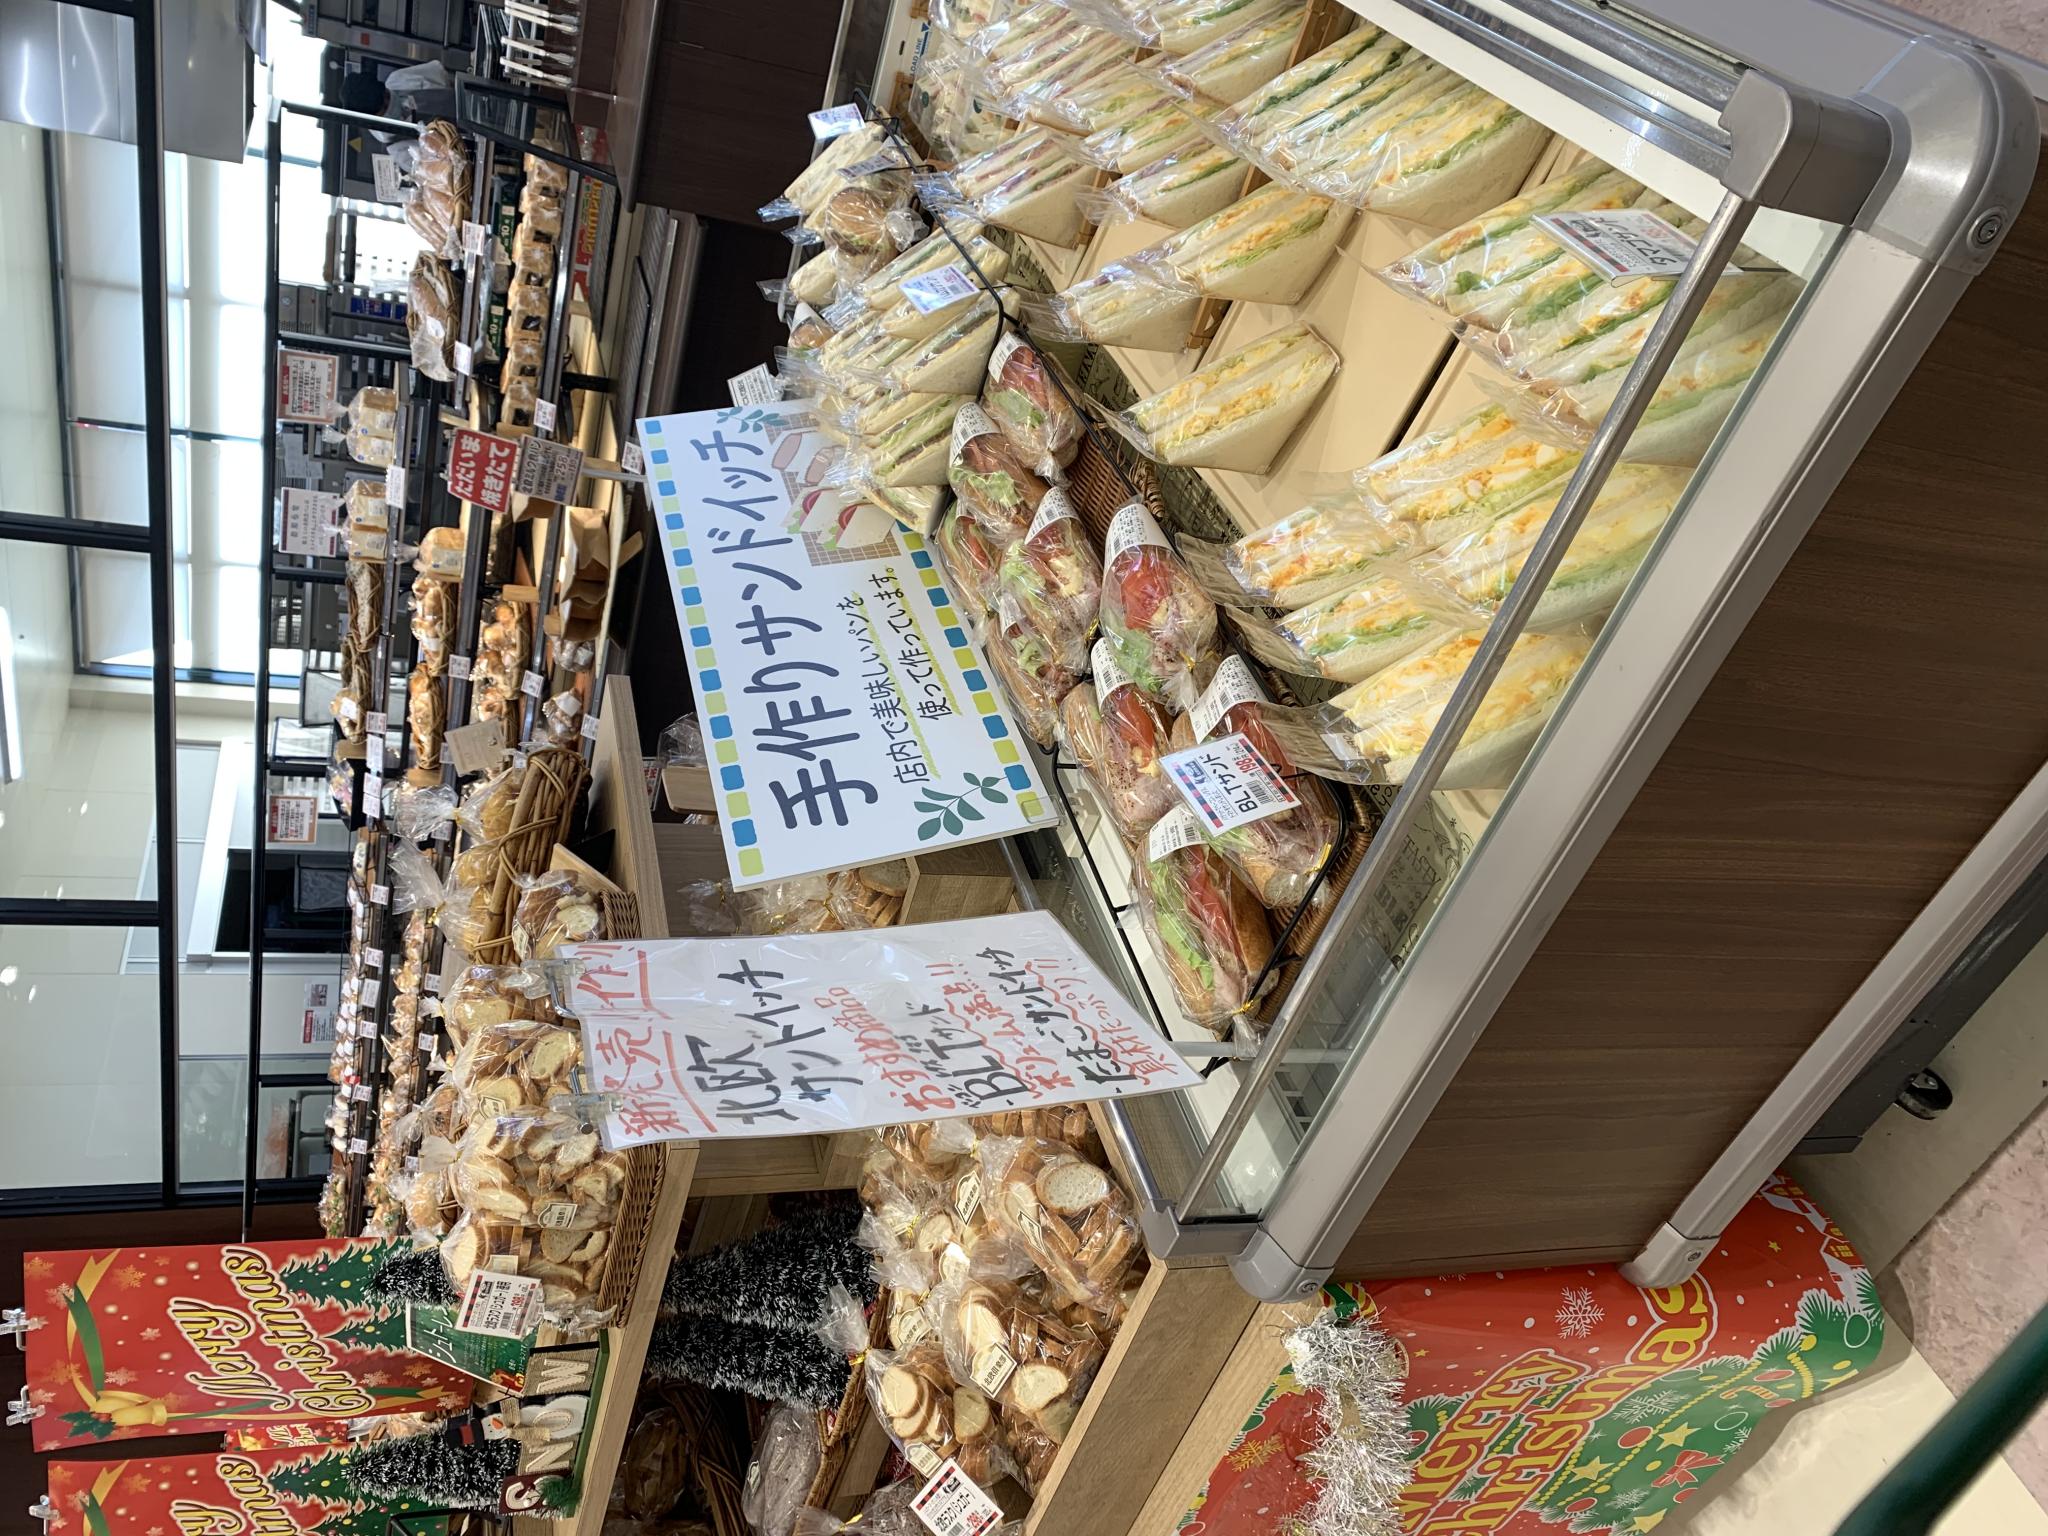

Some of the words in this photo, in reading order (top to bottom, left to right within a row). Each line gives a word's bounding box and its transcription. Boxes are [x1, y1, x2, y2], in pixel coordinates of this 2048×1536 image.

[909, 55, 920, 77] LOAD
[912, 38, 923, 54] LINE
[453, 435, 481, 499] ただいま
[481, 441, 511, 506] 焼きたて
[689, 430, 878, 829] 手作りサンドイッチ
[868, 566, 953, 720] 使って作っています。
[837, 596, 929, 784] 店内で美味しいパンを
[1200, 752, 1259, 813] BLTサンド
[1235, 757, 1257, 774] 198
[684, 1036, 799, 1123] 北欧
[717, 959, 863, 1101] サンドイッチ
[813, 987, 955, 1111] おすすめ商品
[167, 1297, 291, 1409] Merry
[222, 1245, 375, 1417] Christmas
[505, 1358, 590, 1511] SNOW
[1424, 1272, 1708, 1536] hristmas
